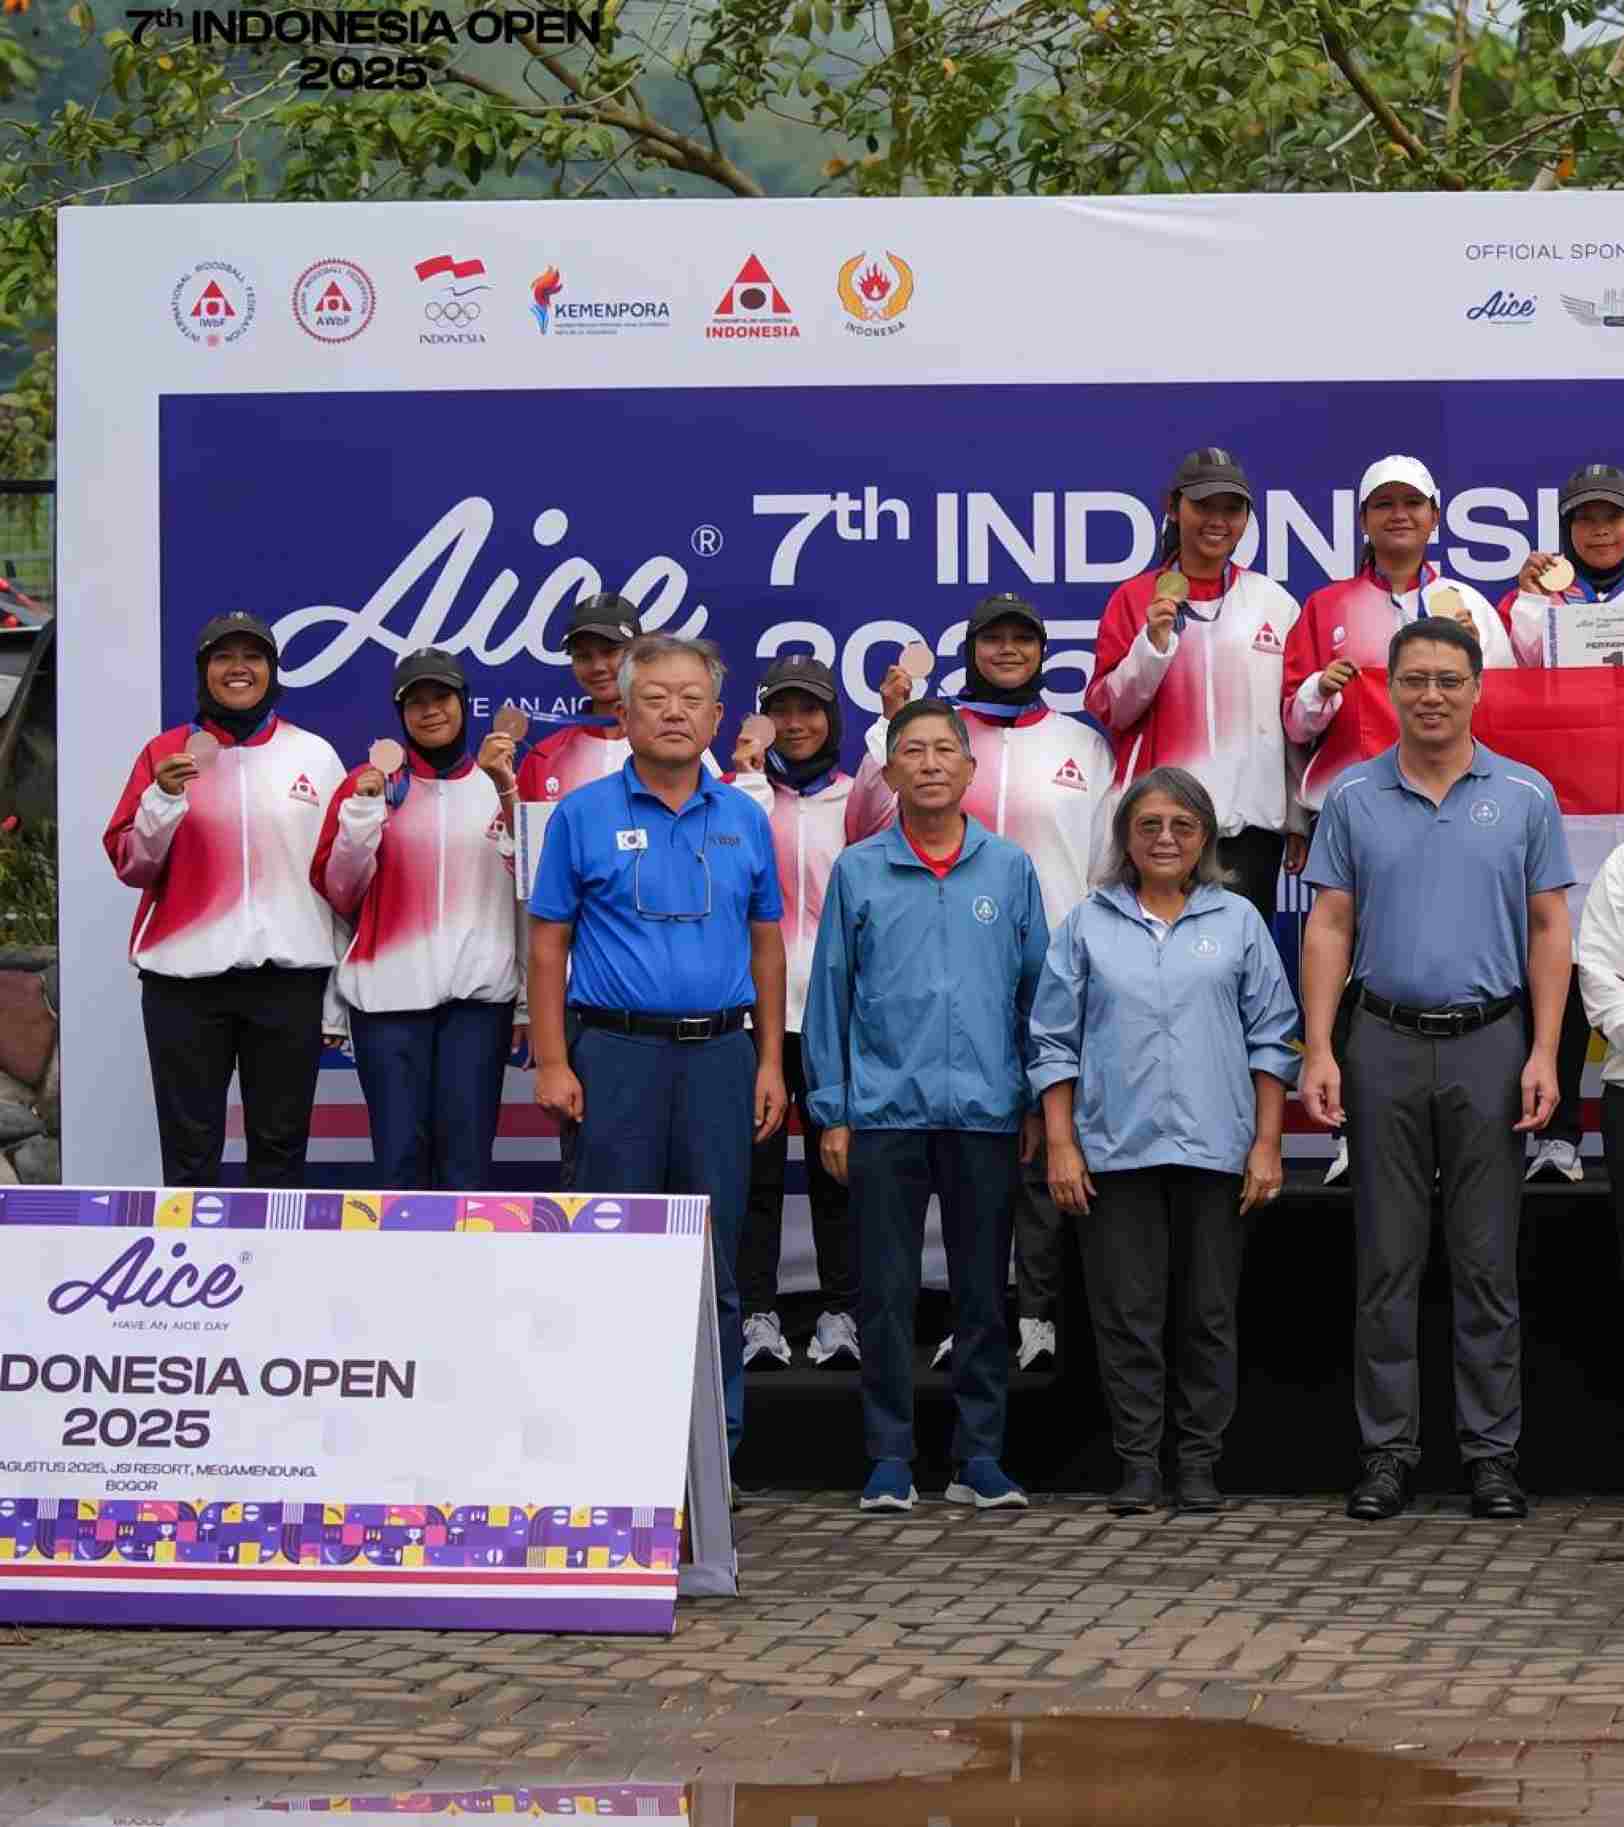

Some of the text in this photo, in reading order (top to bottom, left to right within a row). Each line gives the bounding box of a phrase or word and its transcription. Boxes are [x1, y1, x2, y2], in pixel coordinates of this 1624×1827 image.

[1465, 243, 1564, 260] OFFICIAL
[554, 301, 670, 319] KEMENPORA
[1465, 289, 1537, 320] Aice
[419, 333, 487, 345] INDONESIA
[705, 325, 800, 339] INDONESIA
[845, 321, 908, 337] INDONESIA
[752, 486, 911, 586] 7th
[271, 495, 709, 688] Aice
[47, 1236, 245, 1315] Aice
[259, 1357, 417, 1399] OPEN
[61, 1407, 212, 1449] 2025
[105, 1479, 159, 1492] BOGOR
